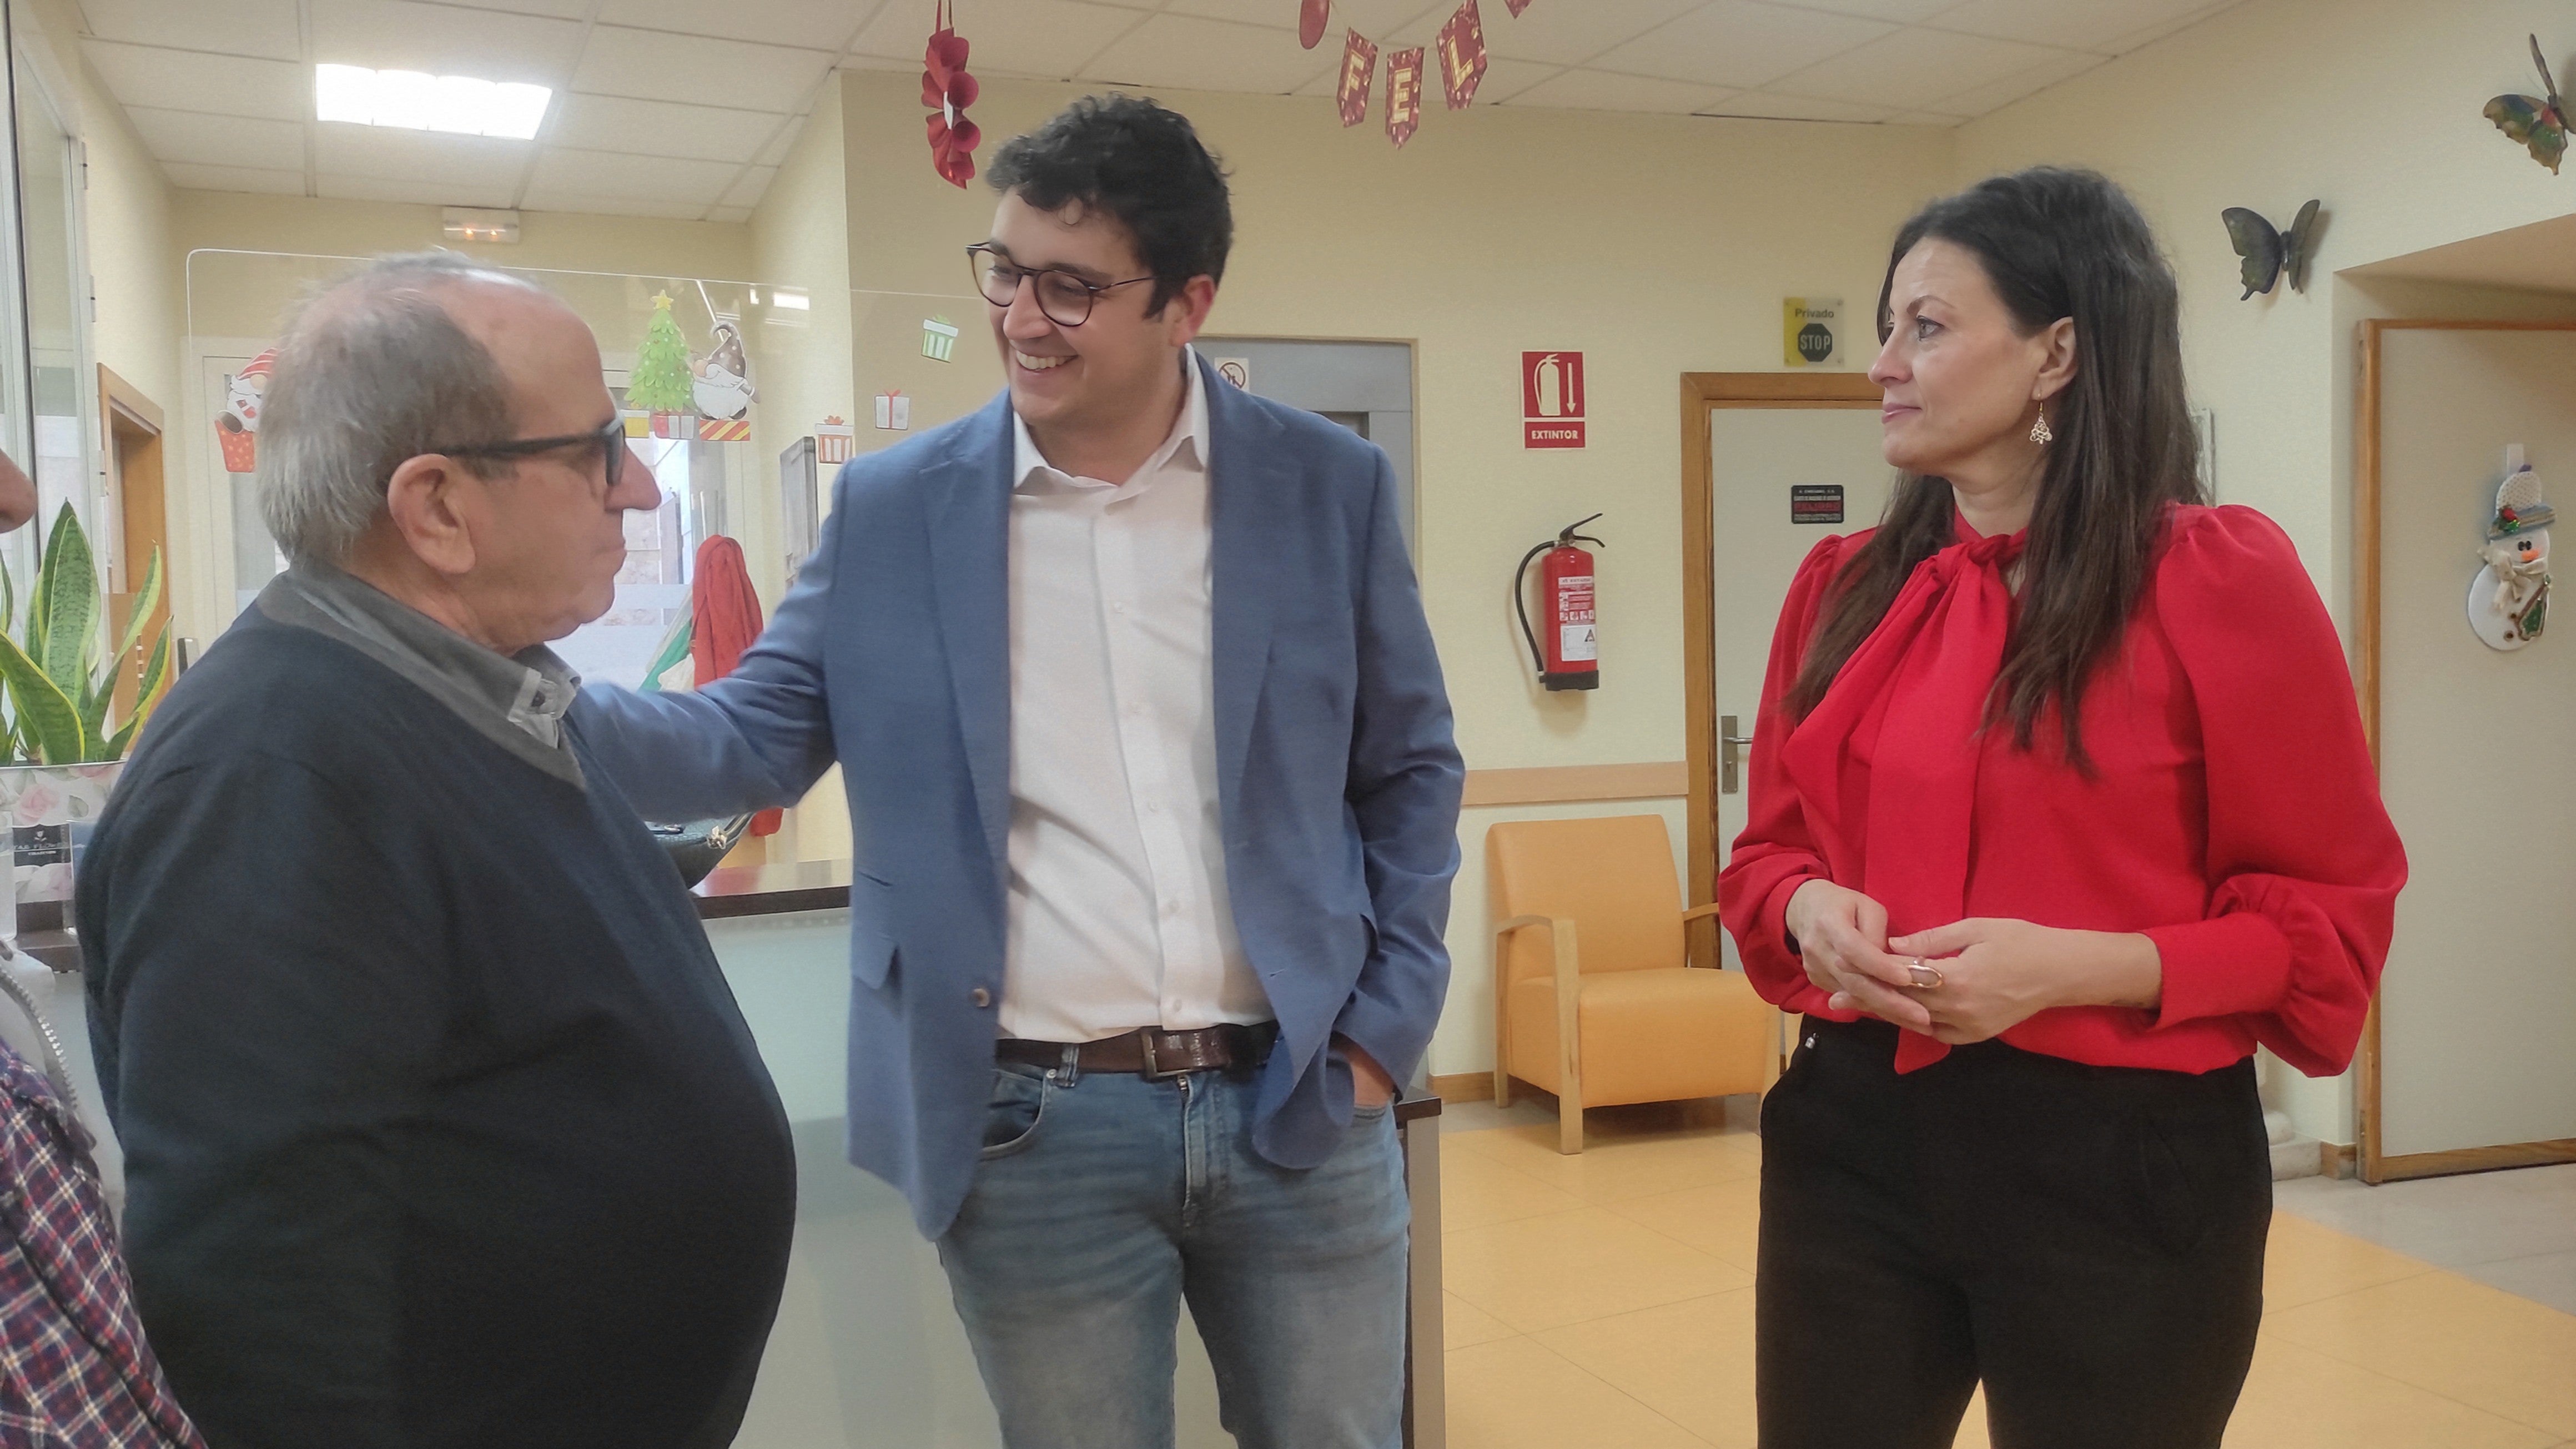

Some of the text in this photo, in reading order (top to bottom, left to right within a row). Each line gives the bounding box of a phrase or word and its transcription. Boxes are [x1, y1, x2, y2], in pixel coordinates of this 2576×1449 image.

[1794, 308, 1834, 318] Privado
[1800, 334, 1831, 350] STOP
[1532, 430, 1578, 440] EXTINTOR
